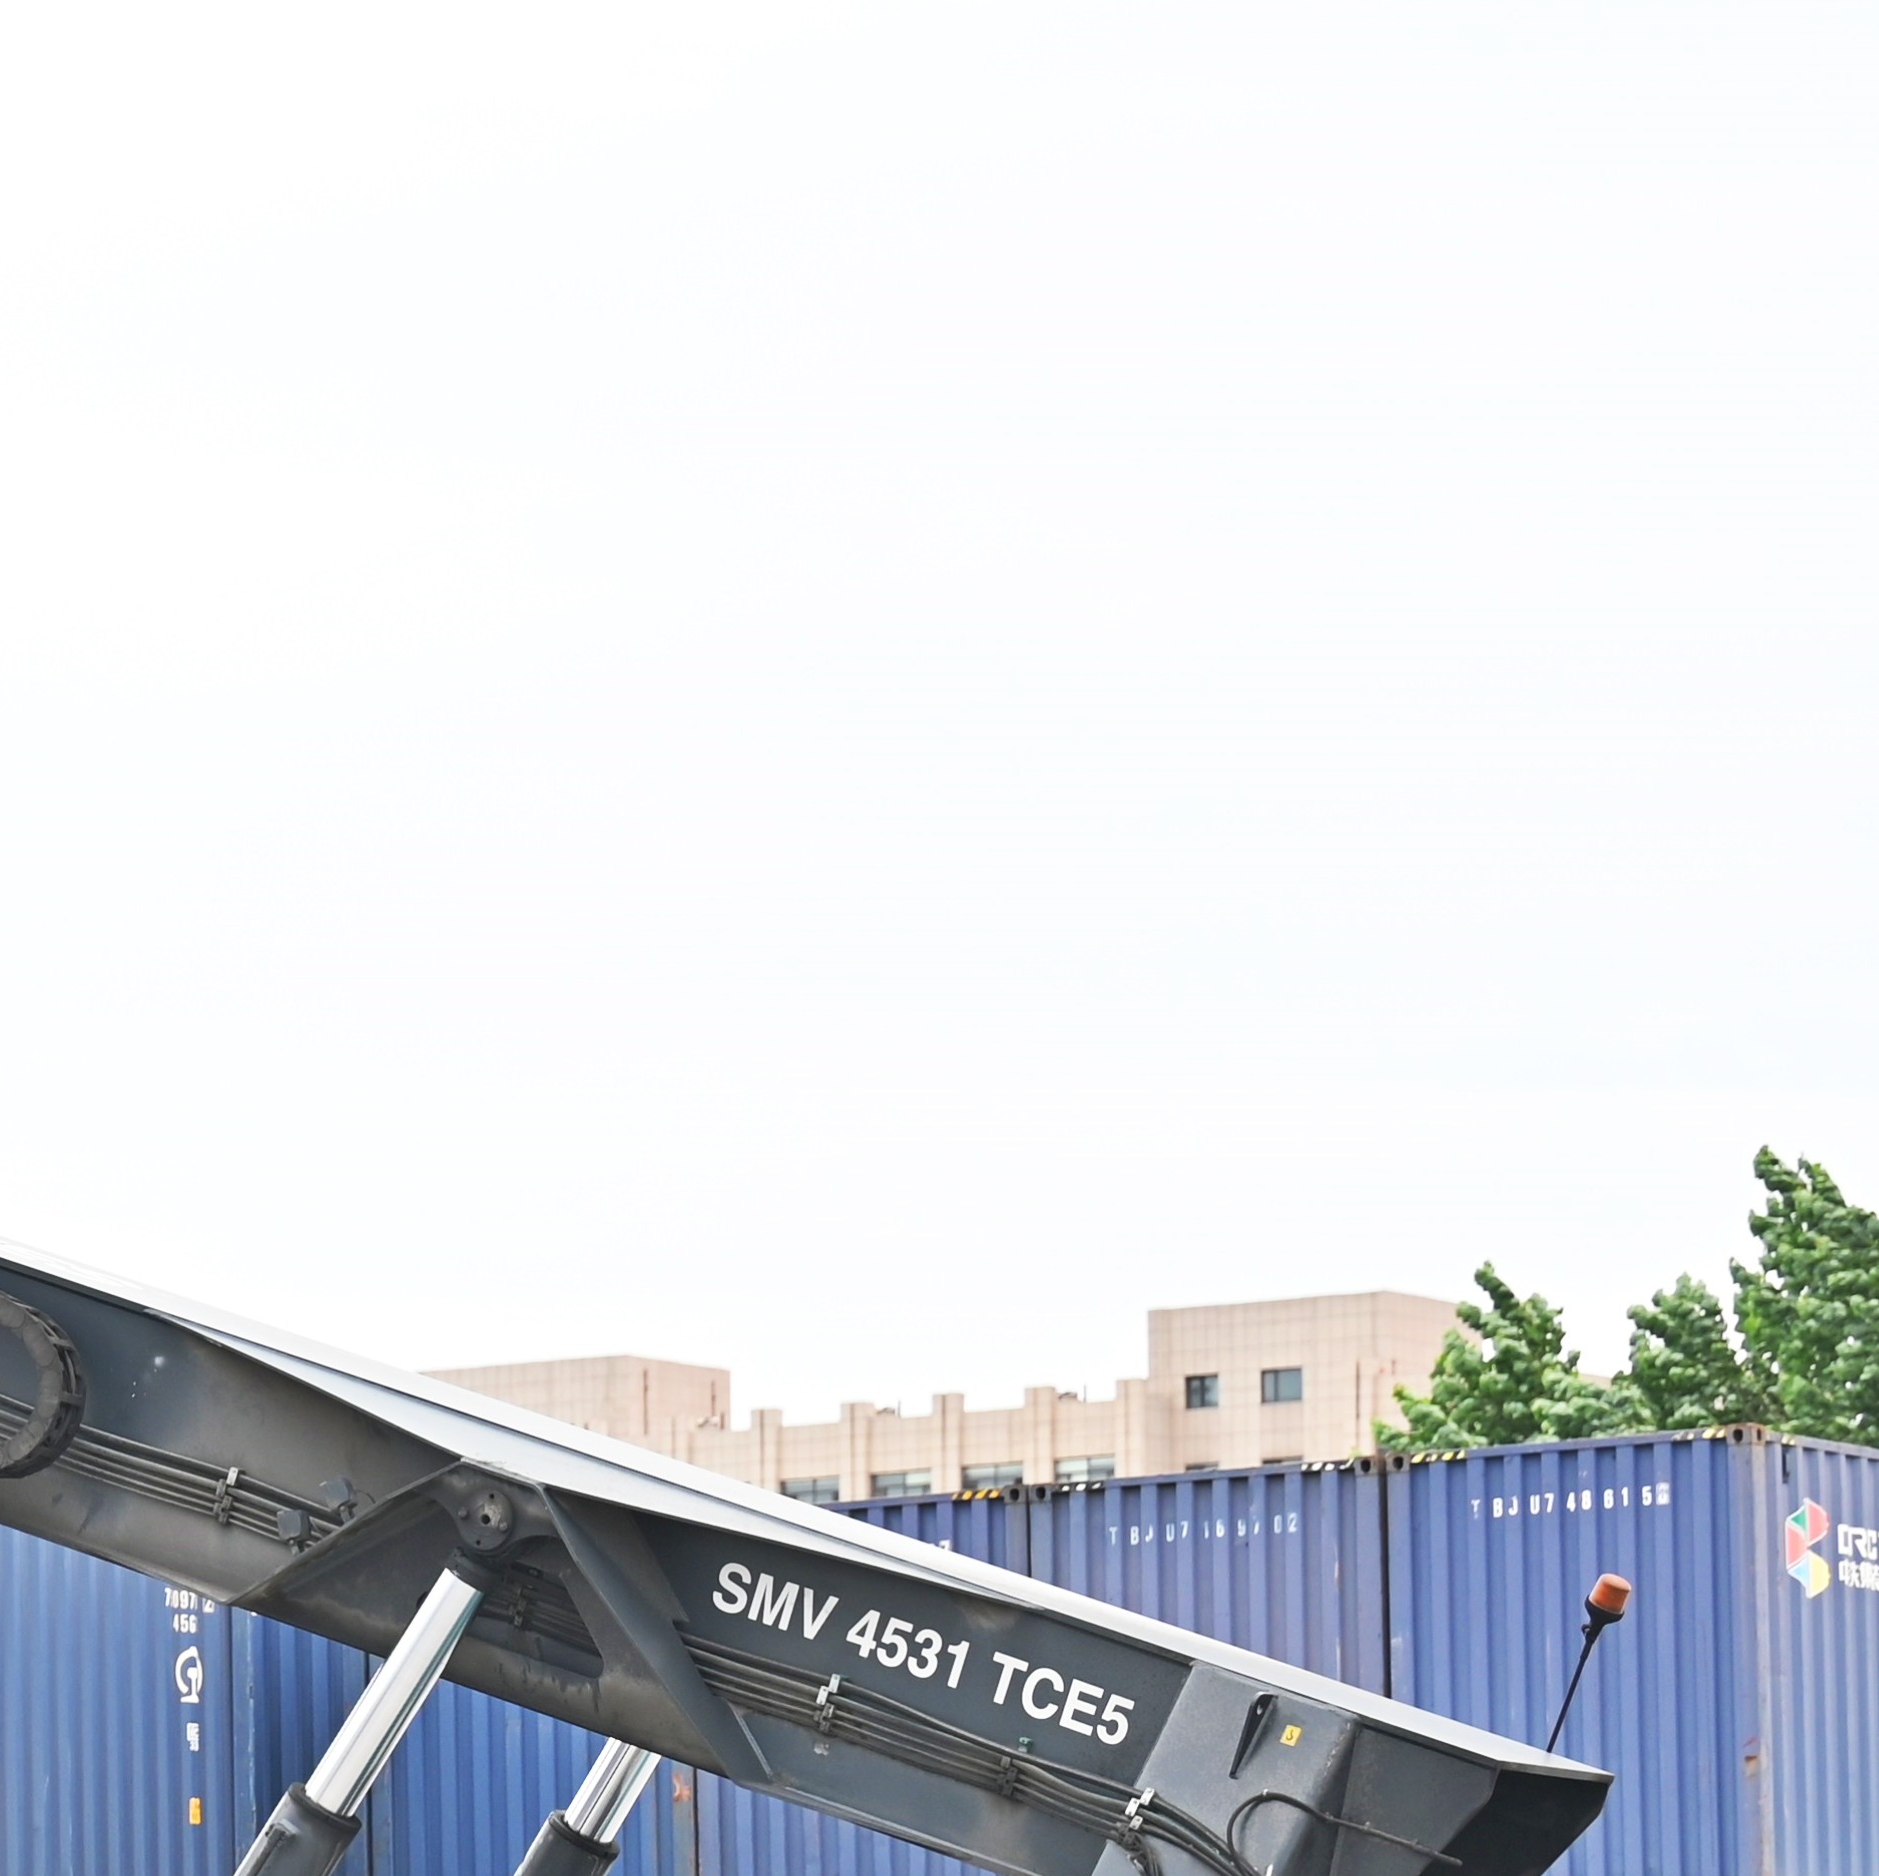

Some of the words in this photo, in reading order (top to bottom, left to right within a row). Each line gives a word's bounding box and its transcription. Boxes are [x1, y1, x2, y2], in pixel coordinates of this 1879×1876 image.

[1837, 1523, 1879, 1561] CRC
[711, 1561, 841, 1642] SMV
[845, 1607, 972, 1690] 4531
[991, 1650, 1137, 1747] TCE5
